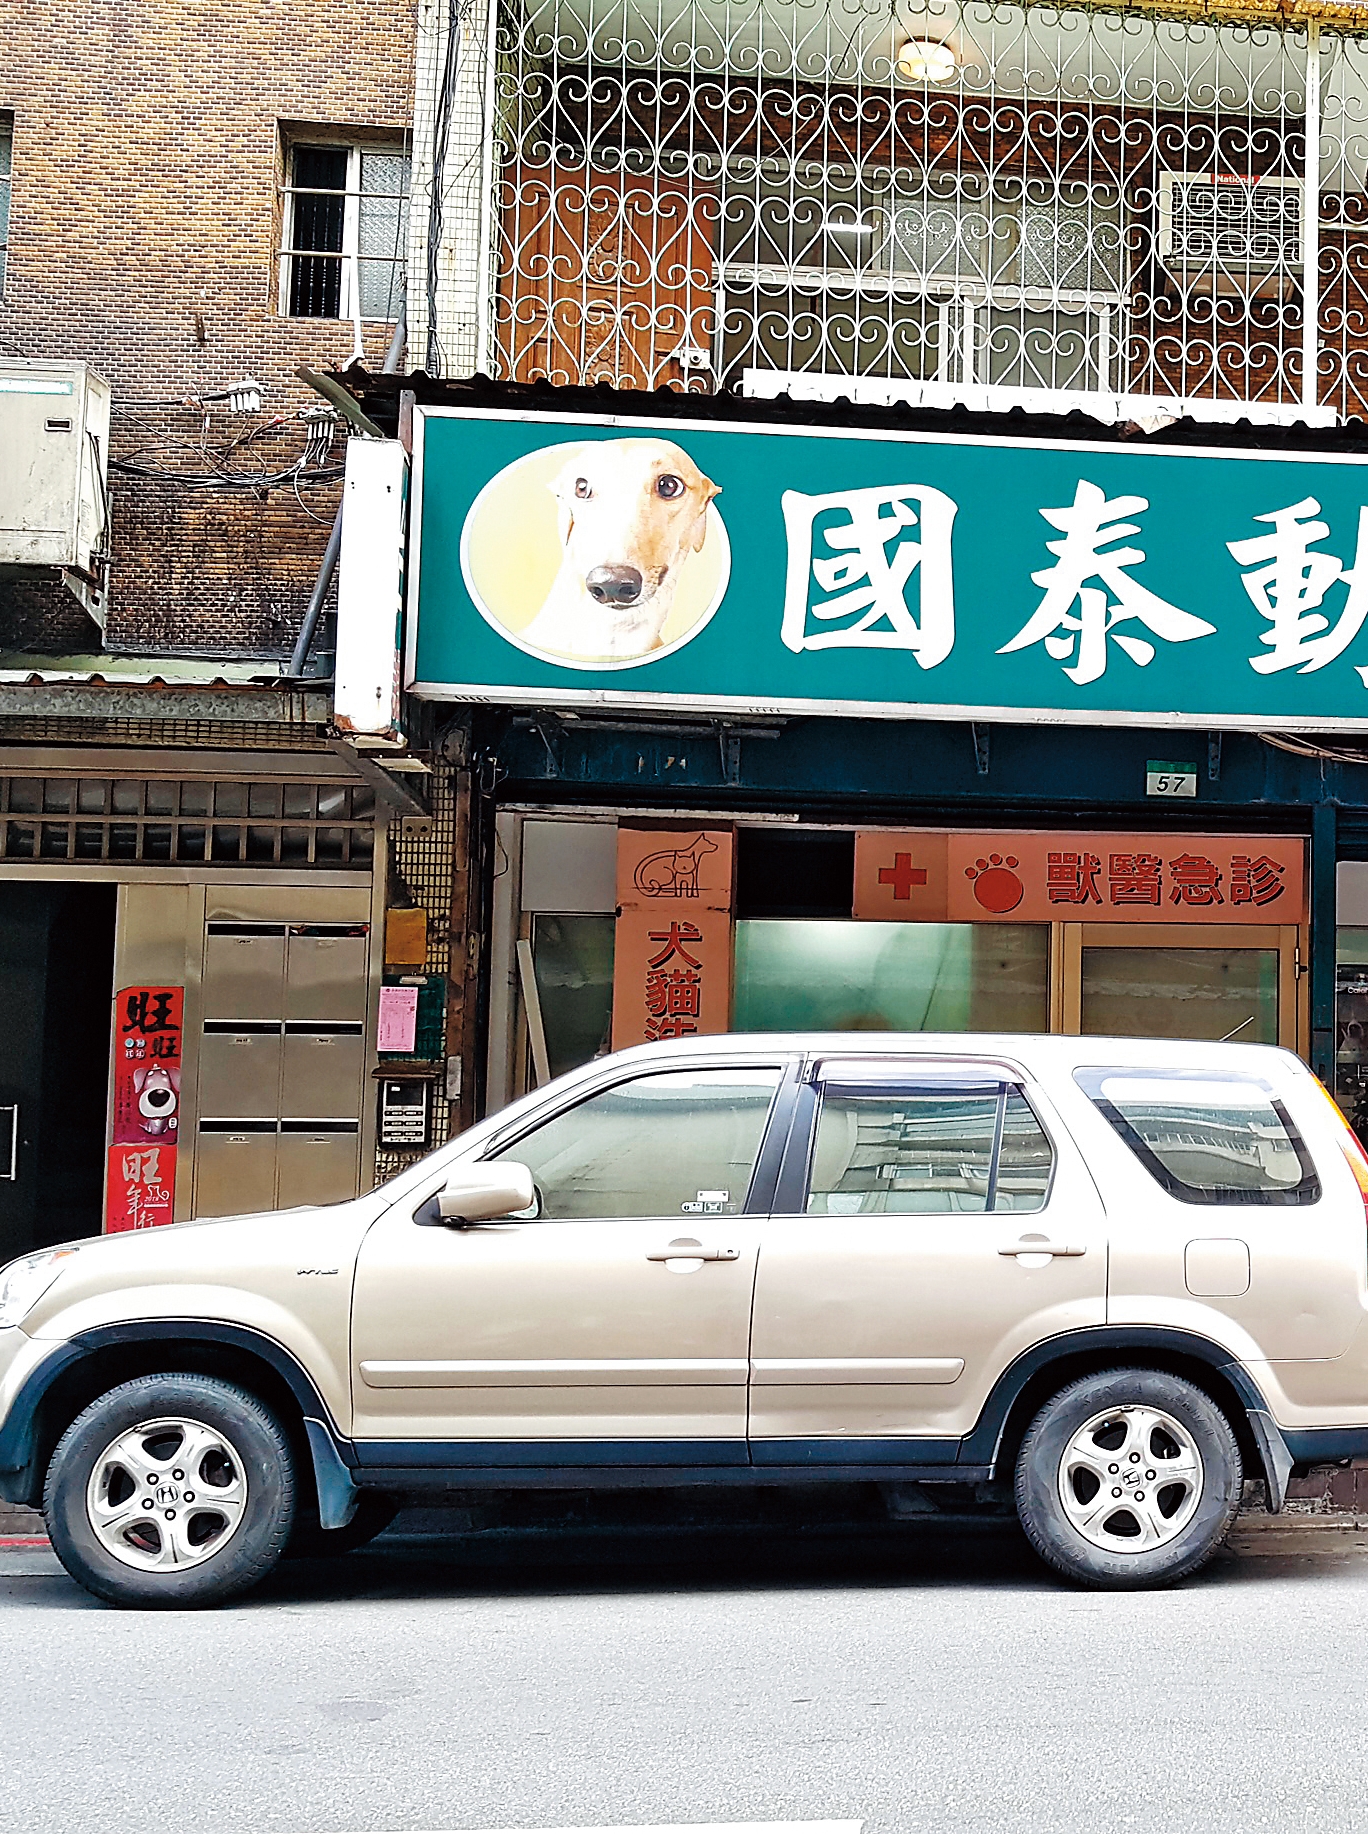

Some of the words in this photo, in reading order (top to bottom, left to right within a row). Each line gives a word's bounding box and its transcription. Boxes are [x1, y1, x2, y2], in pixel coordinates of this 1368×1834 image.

[1156, 775, 1186, 793] 57
[1046, 852, 1287, 907] 獸醫急診
